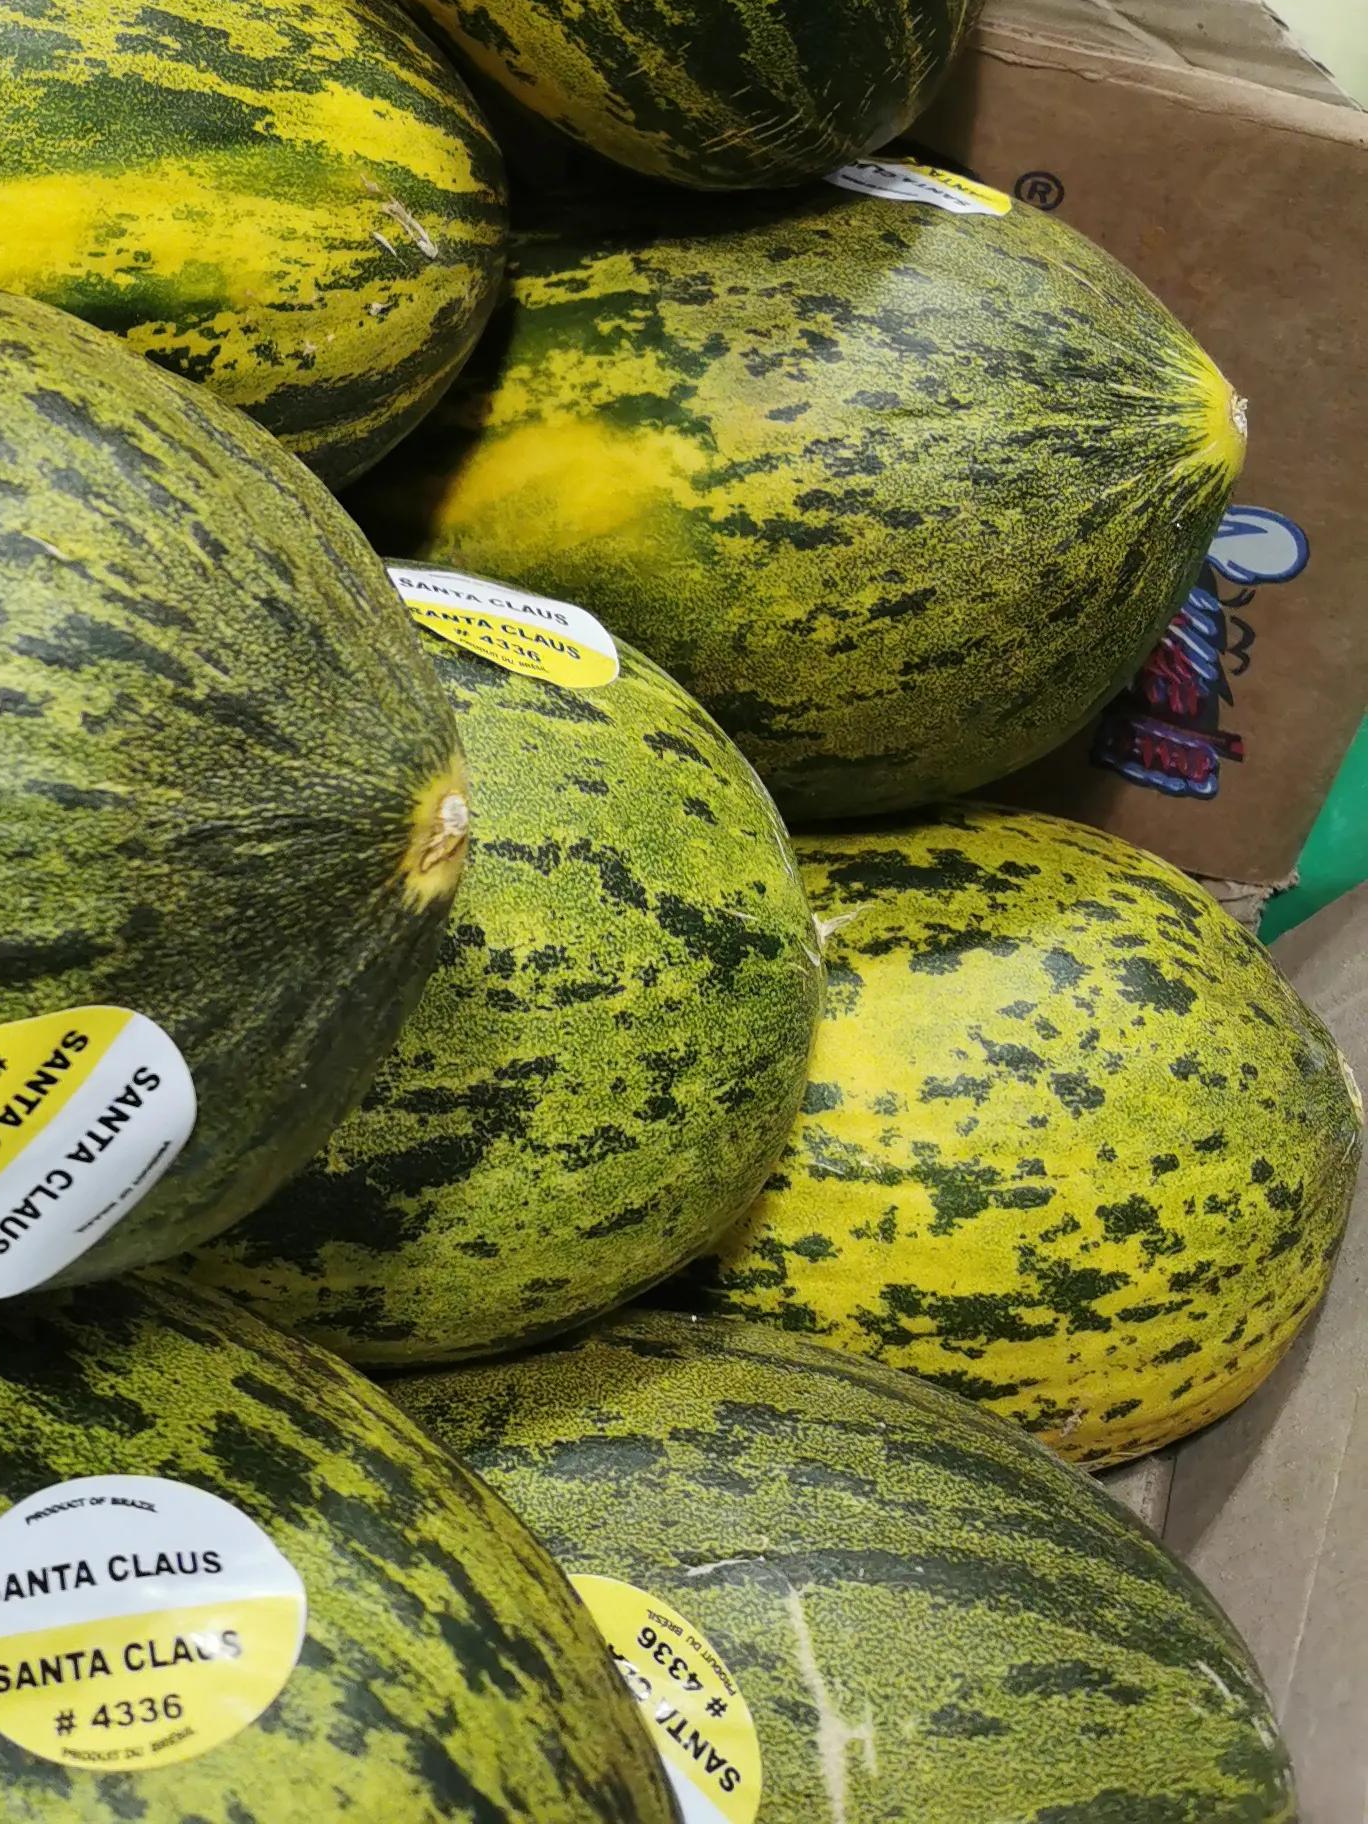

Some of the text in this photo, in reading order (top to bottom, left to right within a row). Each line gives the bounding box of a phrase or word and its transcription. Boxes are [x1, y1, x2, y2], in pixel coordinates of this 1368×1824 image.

[399, 576, 482, 604] SANTA
[489, 597, 570, 627] CLAUS
[501, 623, 581, 661] CLAUS
[66, 1066, 161, 1164] SANTA
[107, 1550, 223, 1582] CLAUS
[636, 1626, 705, 1692] 4336
[55, 1693, 184, 1737] # 4336
